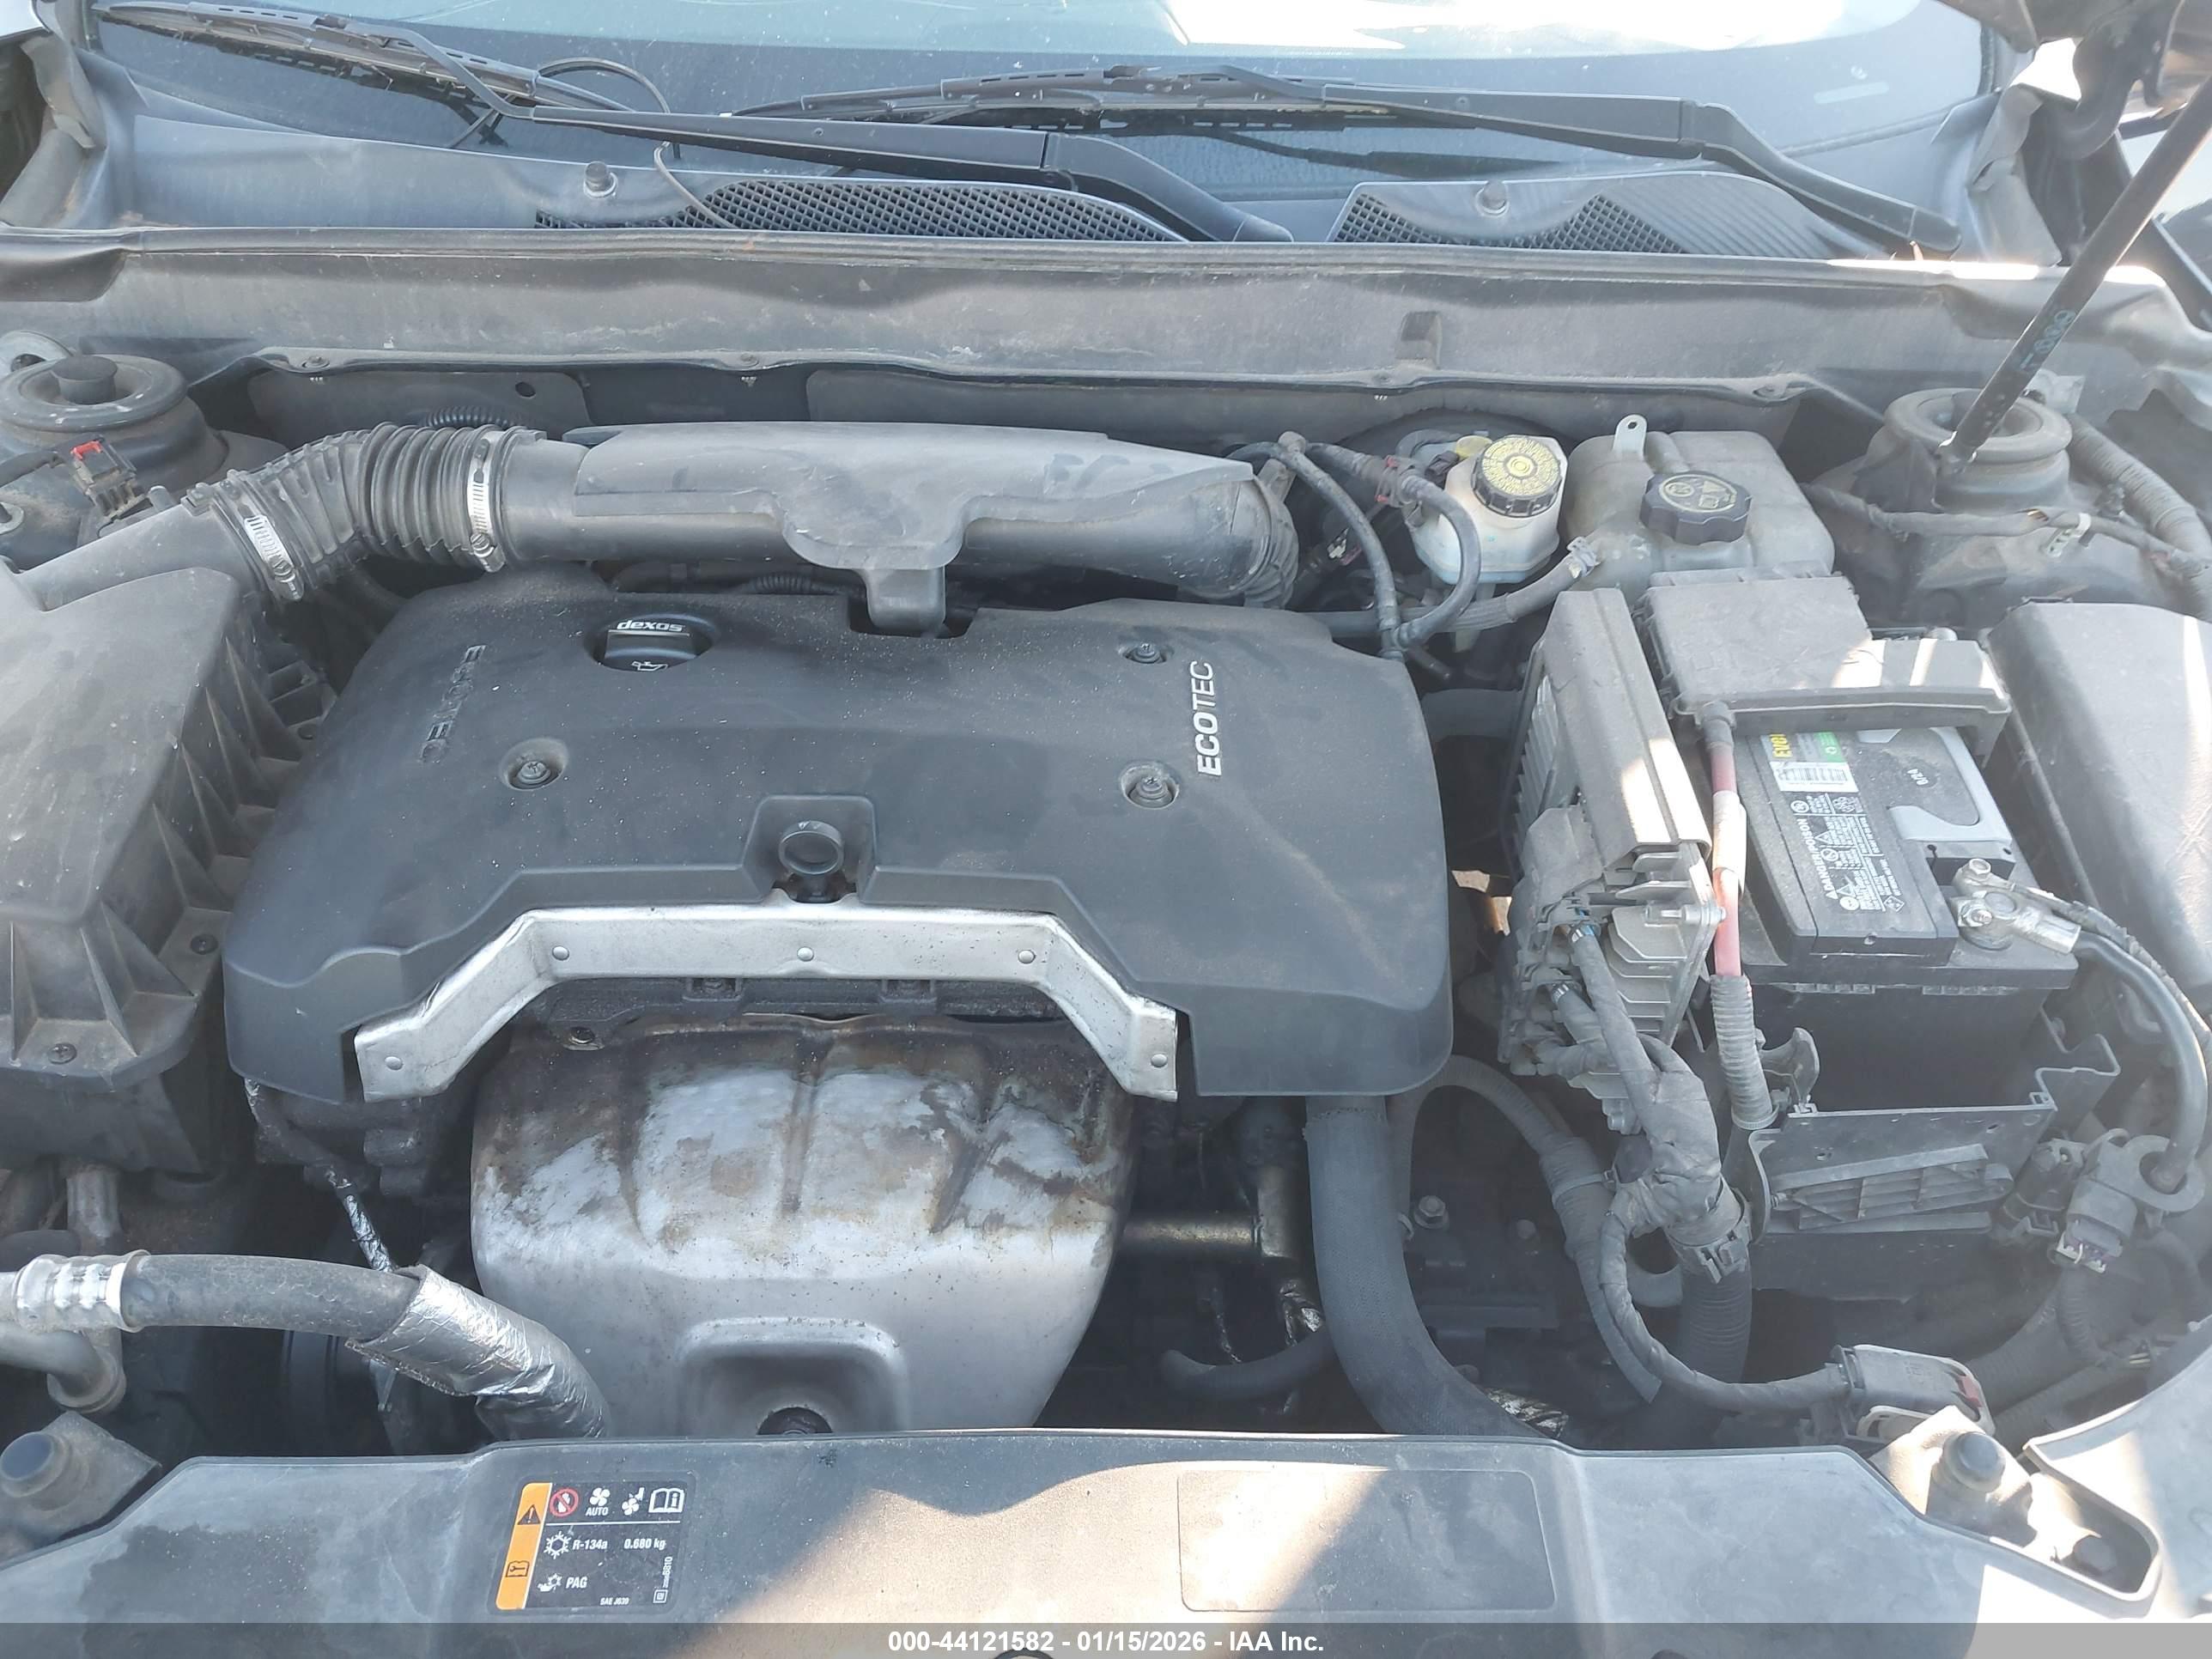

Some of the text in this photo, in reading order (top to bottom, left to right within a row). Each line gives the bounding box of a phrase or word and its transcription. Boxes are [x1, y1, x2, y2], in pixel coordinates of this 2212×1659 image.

[617, 619, 684, 632] dexos
[1190, 661, 1222, 776] ECOTEC
[586, 1507, 609, 1516] AUTO
[573, 1539, 608, 1551] R-134a
[653, 1538, 666, 1551] kg
[567, 1577, 588, 1589] PAG
